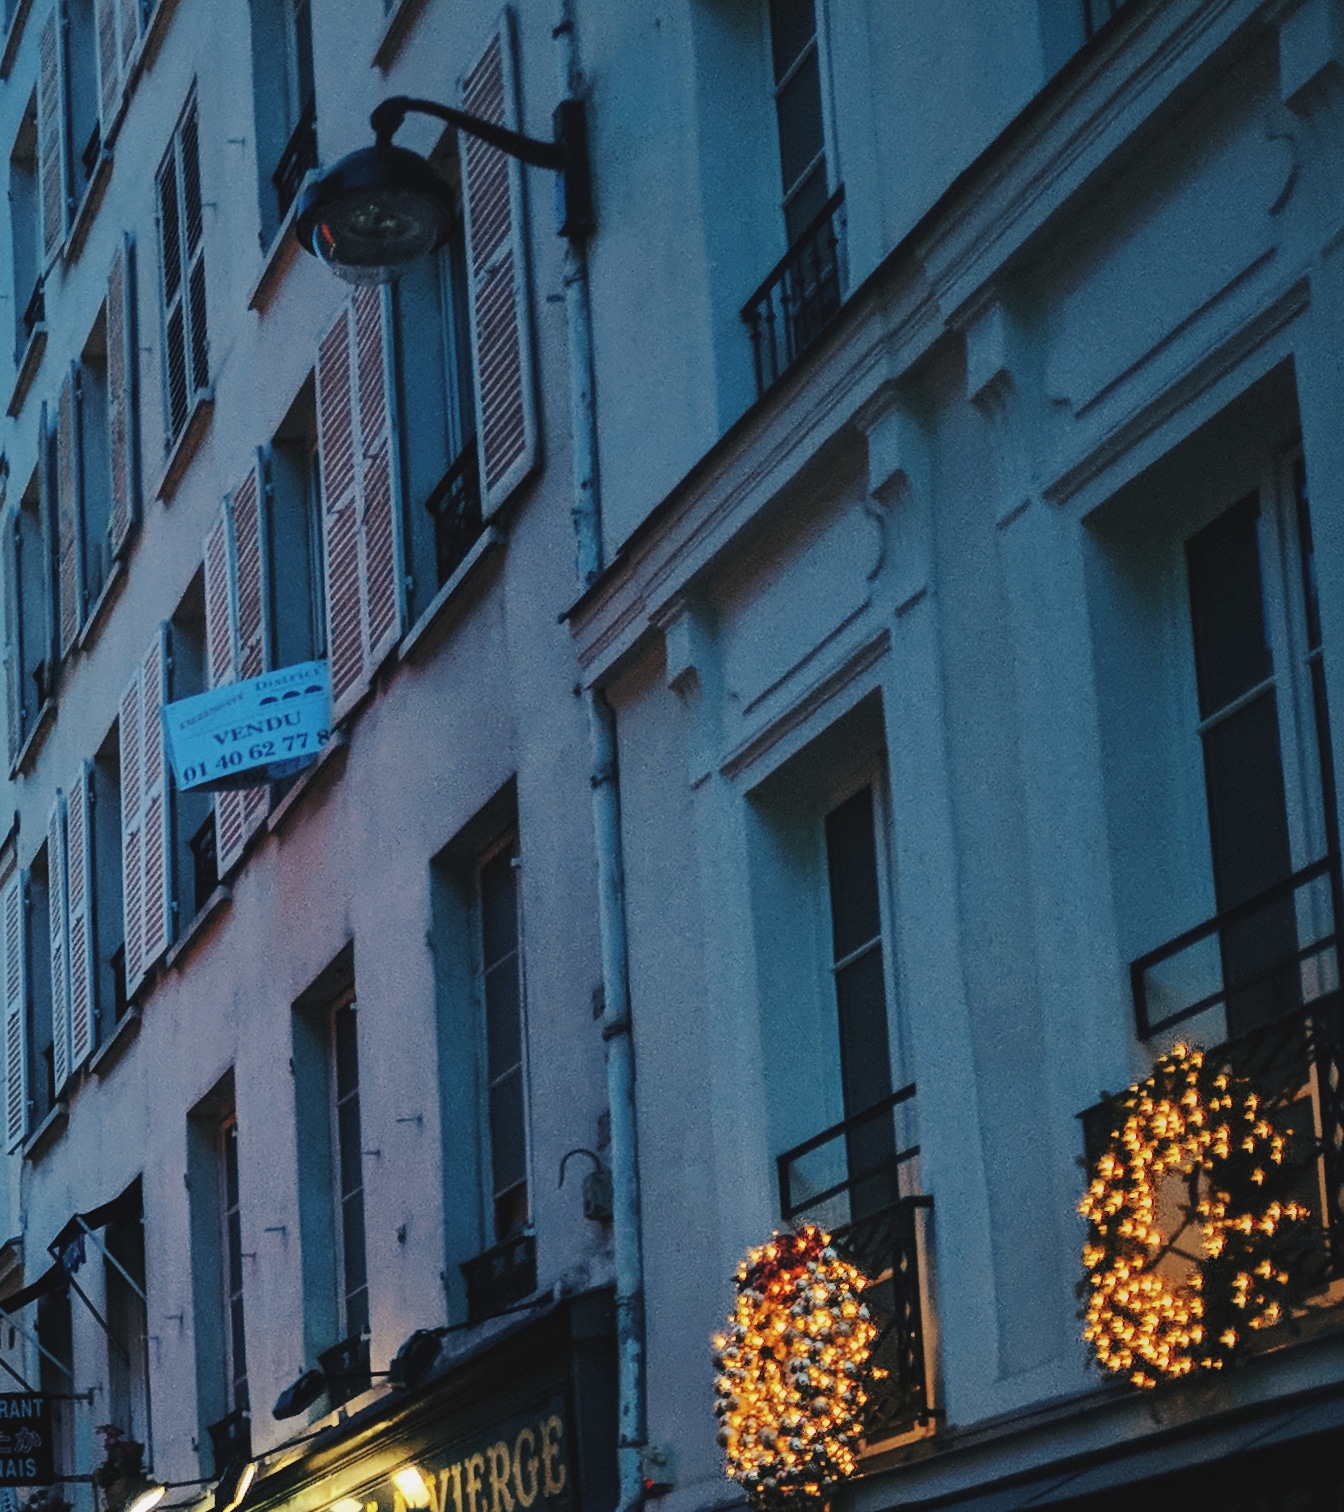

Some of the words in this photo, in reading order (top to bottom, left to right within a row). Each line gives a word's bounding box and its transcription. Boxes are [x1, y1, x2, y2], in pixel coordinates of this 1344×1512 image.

[213, 711, 301, 745] VENDU
[183, 762, 207, 782] 01
[216, 751, 243, 770] 40
[249, 741, 276, 760] 62
[281, 733, 308, 751] 77
[316, 729, 331, 746] 8
